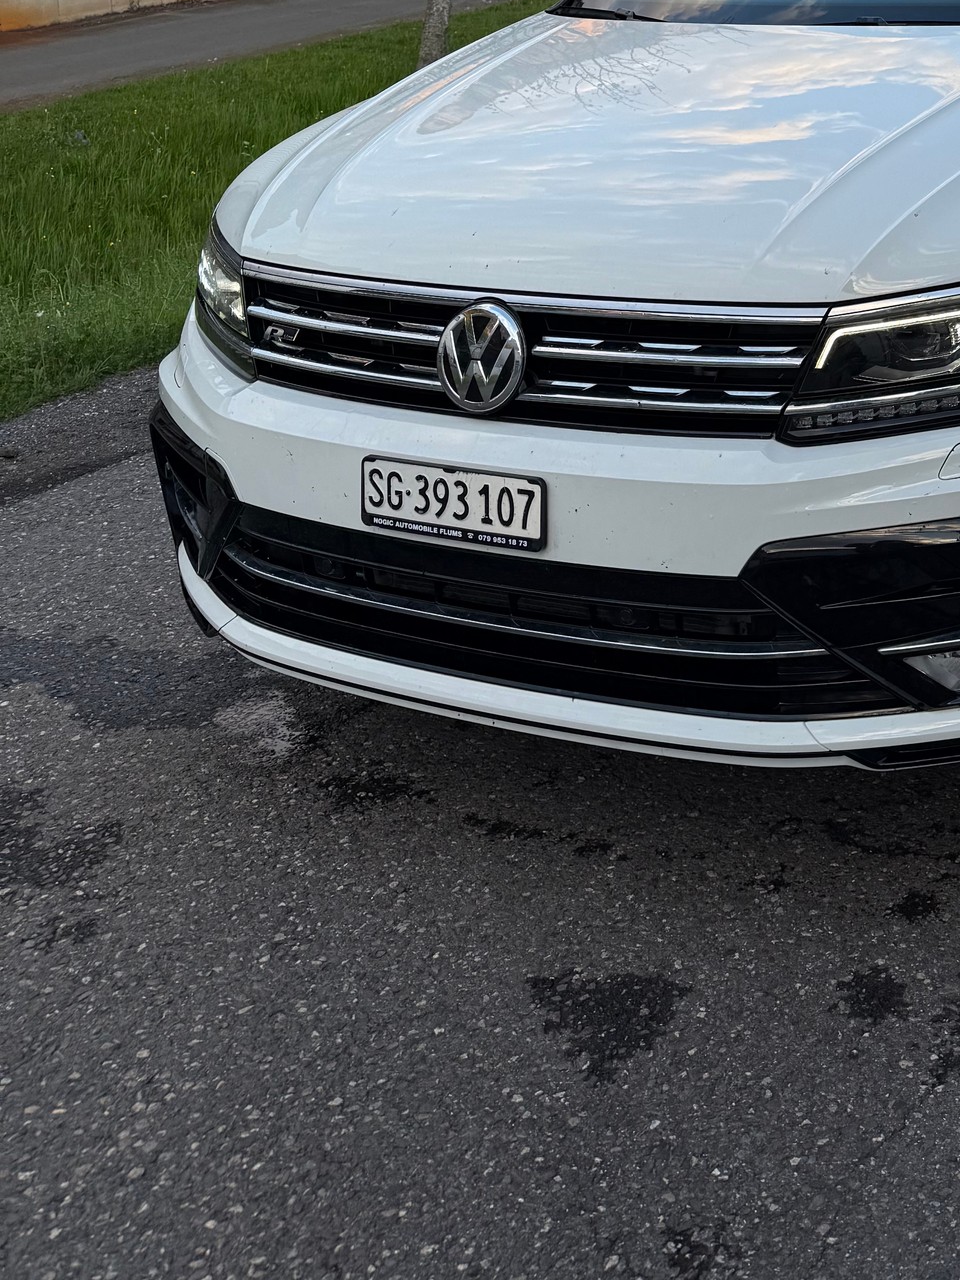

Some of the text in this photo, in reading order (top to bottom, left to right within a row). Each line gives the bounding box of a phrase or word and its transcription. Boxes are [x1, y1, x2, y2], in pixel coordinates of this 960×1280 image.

[395, 521, 438, 534] AUTOMOBILE
[439, 528, 463, 538] FLUMS
[478, 534, 491, 542] 079
[492, 536, 506, 544] 953
[508, 538, 517, 546] 18
